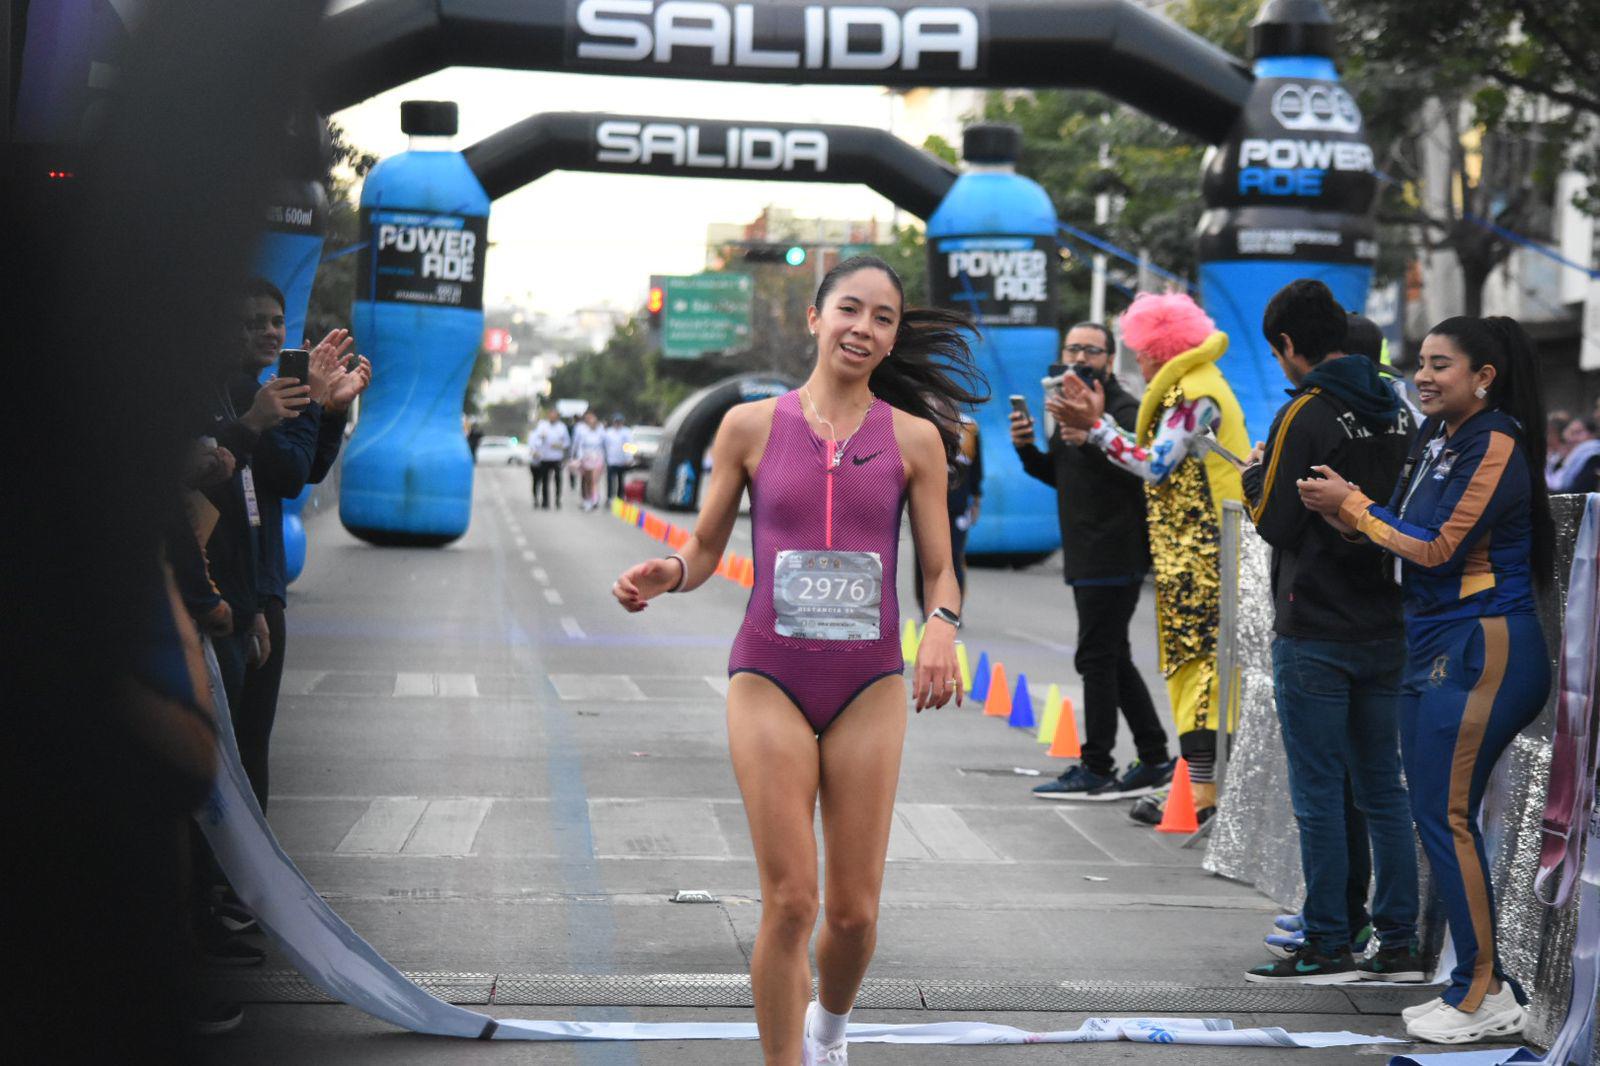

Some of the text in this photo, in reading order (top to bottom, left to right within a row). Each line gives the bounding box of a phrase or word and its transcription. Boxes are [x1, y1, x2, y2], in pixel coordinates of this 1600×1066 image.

[577, 0, 979, 71] SALIDA
[596, 121, 828, 172] SALIDA
[1238, 138, 1374, 173] POWER
[1238, 168, 1328, 197] ADE
[379, 224, 476, 257] POWER
[421, 252, 476, 283] ADE
[948, 249, 1047, 279] POWER
[994, 276, 1047, 301] ADE
[798, 577, 865, 601] 2976
